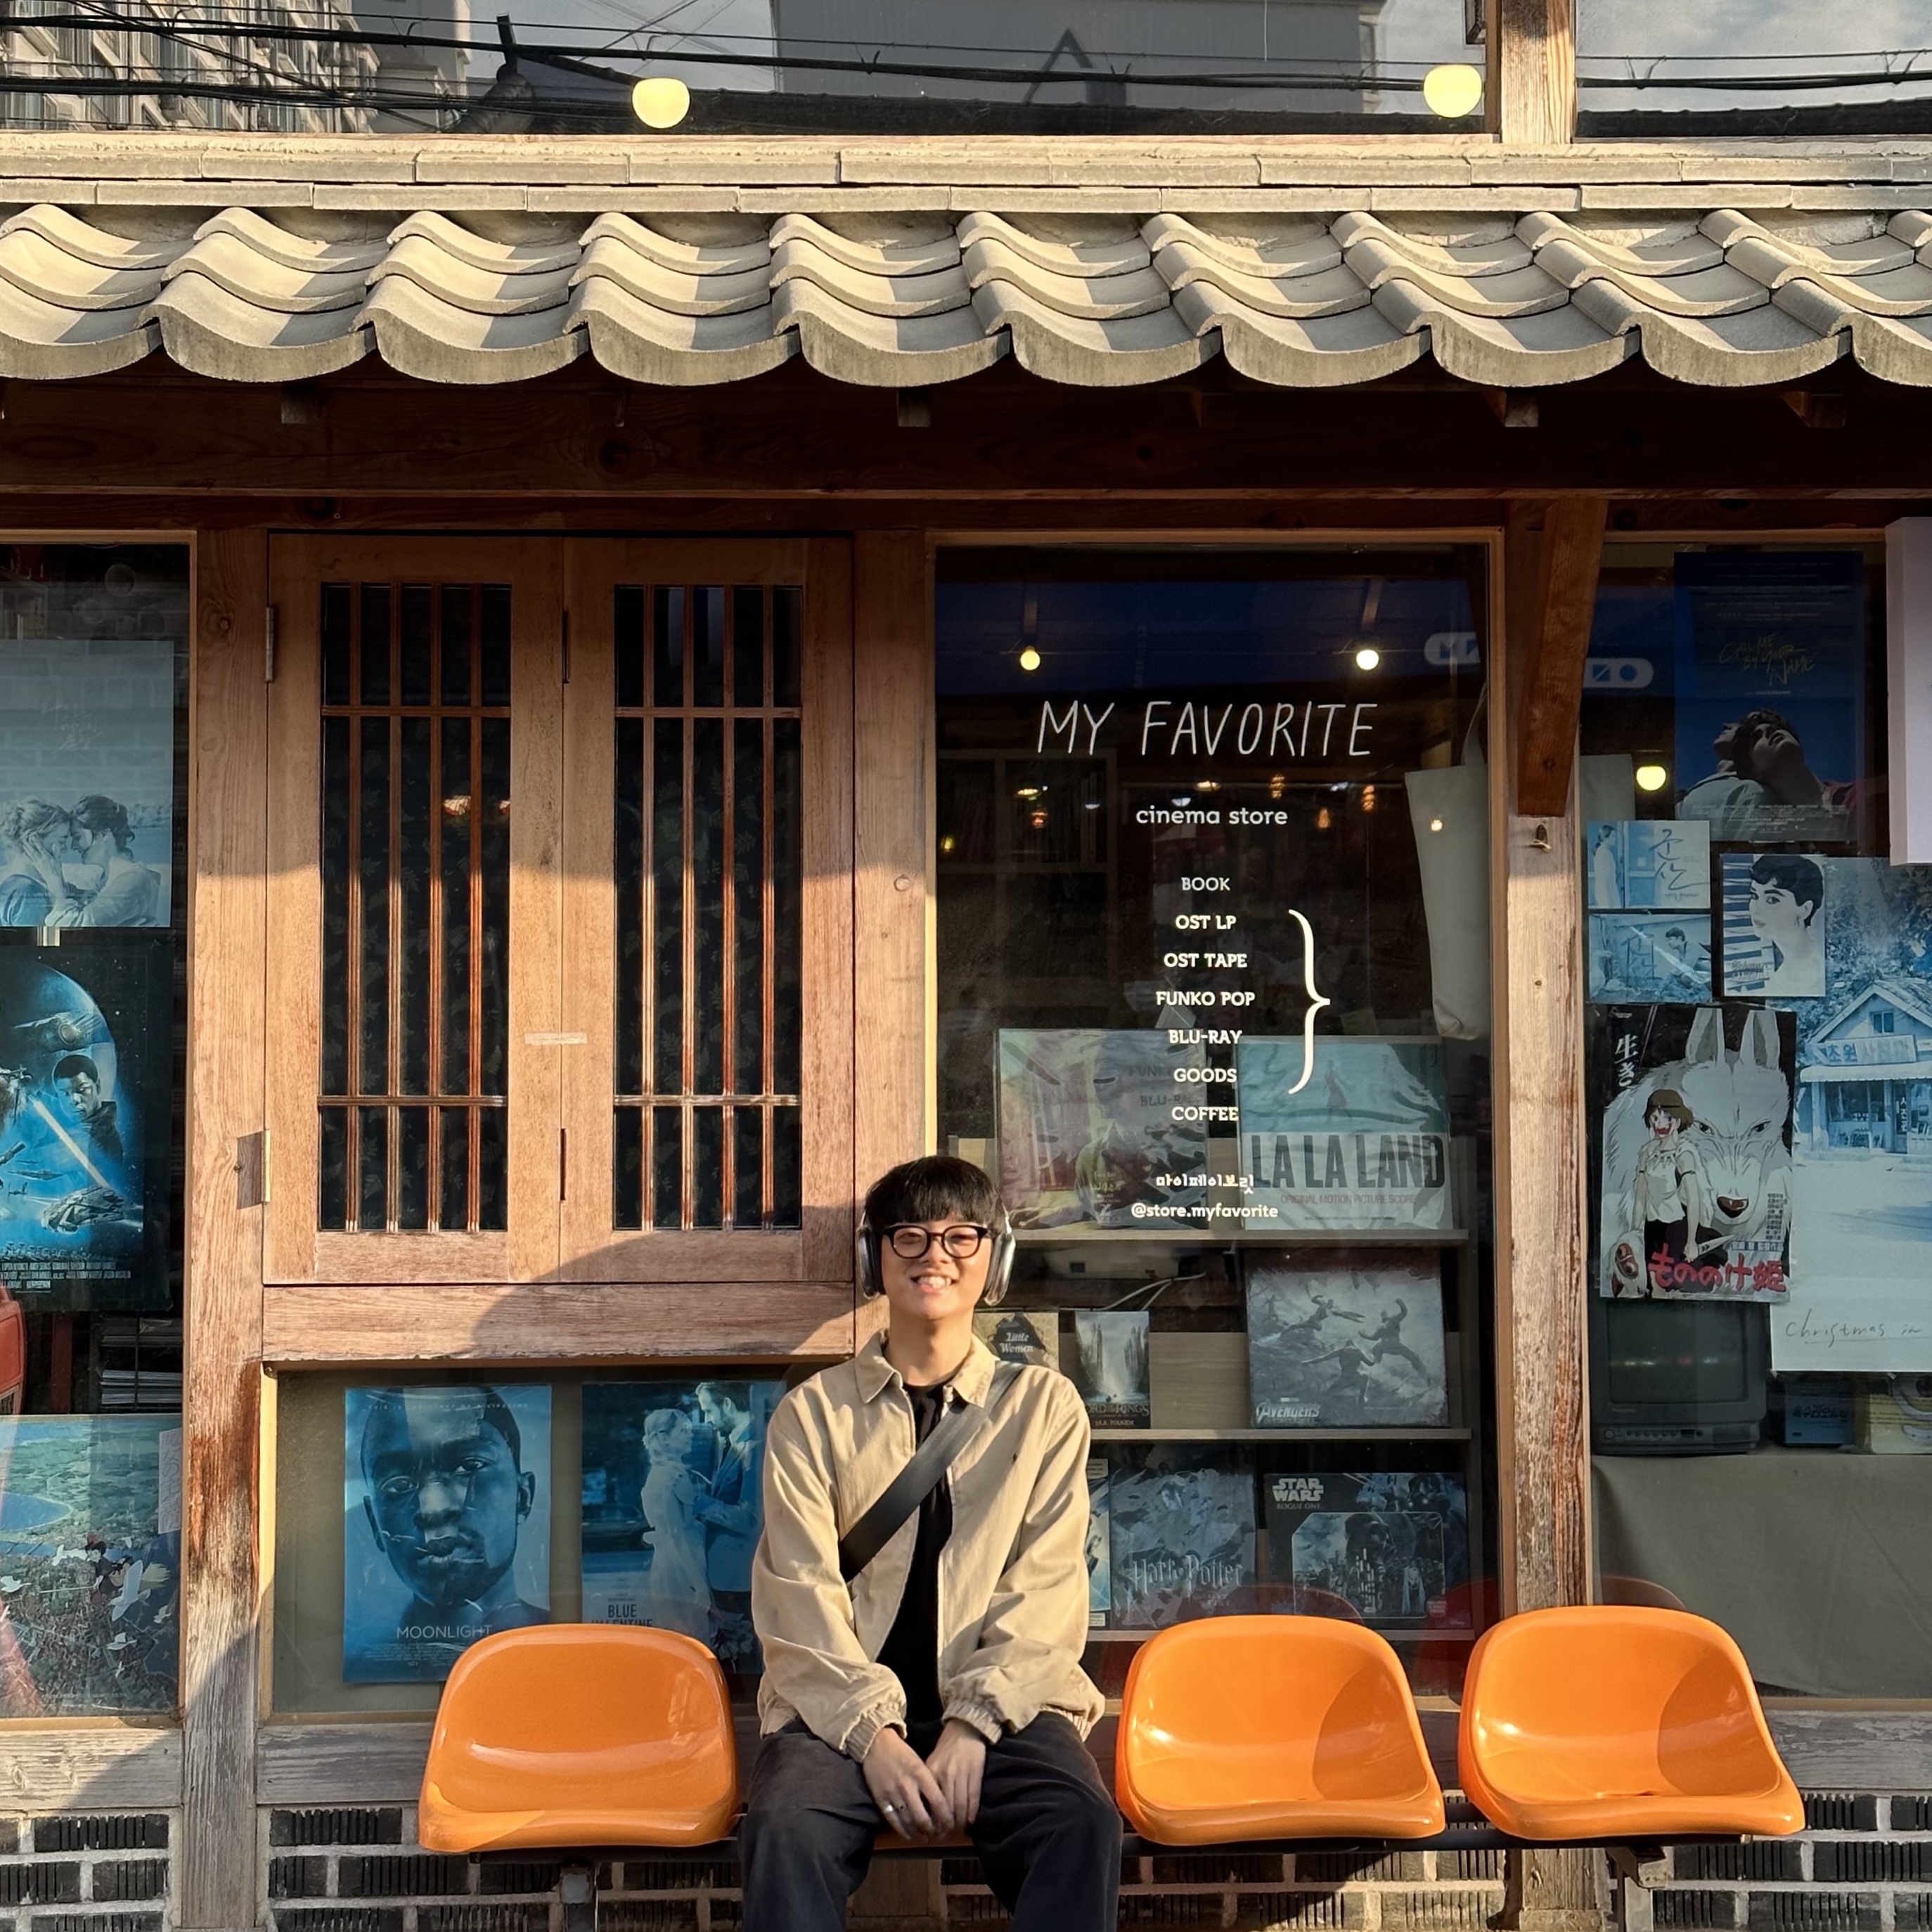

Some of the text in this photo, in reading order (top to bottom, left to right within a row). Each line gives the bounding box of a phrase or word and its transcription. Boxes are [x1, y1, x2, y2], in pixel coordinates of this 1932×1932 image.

[1038, 700, 1378, 757] MY FAVORITE
[1136, 806, 1288, 825] cinema store
[1181, 877, 1230, 891] BOOK
[1175, 915, 1237, 929] OST LP
[1164, 953, 1248, 968] OST TAPE
[1155, 991, 1256, 1006] FUNKO POP
[1168, 1029, 1242, 1045] BLU-RAY
[1173, 1068, 1237, 1083] GOODS
[1171, 1106, 1239, 1121] COFFEE
[1251, 1135, 1445, 1188] LA LA LAND
[1156, 1173, 1254, 1194] 마이페이보릿
[1131, 1202, 1279, 1221] @store.myfavorite
[1648, 1242, 1786, 1292] もののけ姫
[1786, 1308, 1885, 1348] Christmas
[1005, 1332, 1030, 1343] Little
[999, 1343, 1034, 1353] Women
[1086, 1403, 1107, 1414] ORD
[1116, 1403, 1149, 1417] RINGS
[1256, 1398, 1321, 1424] AVENGERS
[1272, 1478, 1324, 1490] STAR
[1273, 1489, 1324, 1502] WARS
[1184, 1554, 1244, 1602] Potter
[607, 1604, 637, 1618] BLUE
[397, 1624, 493, 1639] MOONLIGHT
